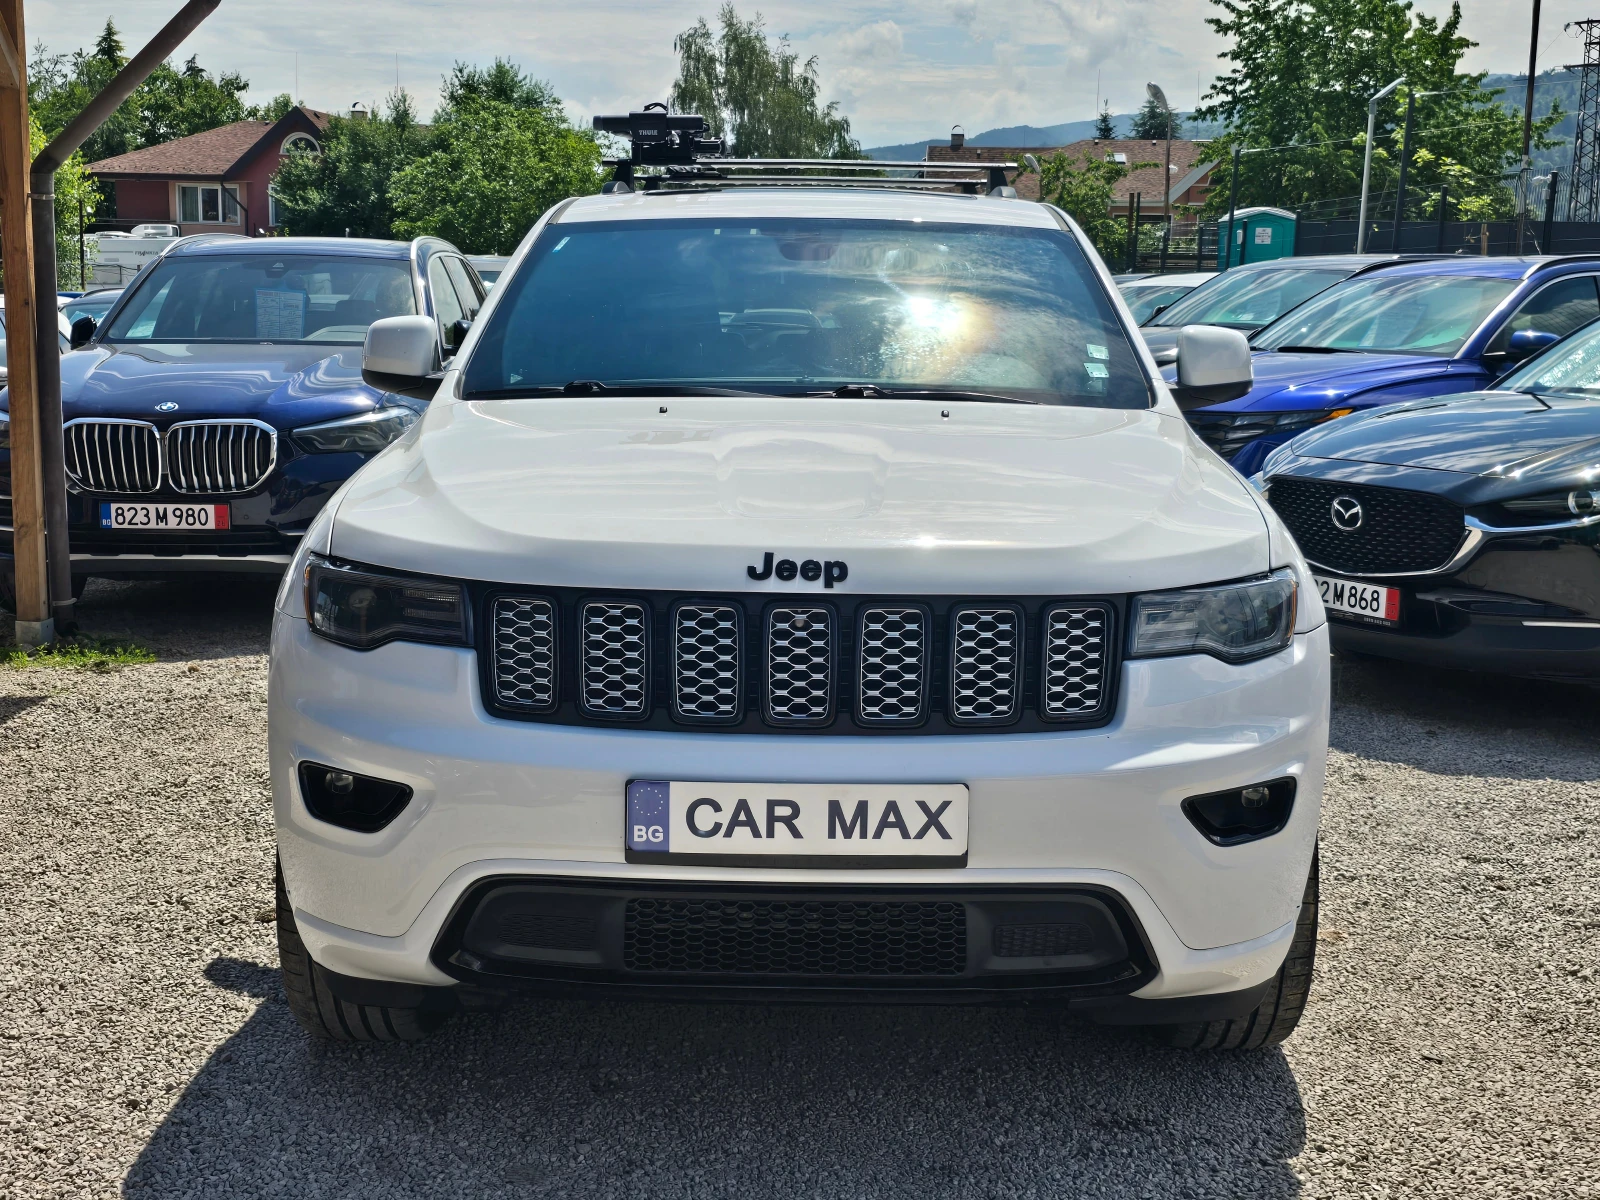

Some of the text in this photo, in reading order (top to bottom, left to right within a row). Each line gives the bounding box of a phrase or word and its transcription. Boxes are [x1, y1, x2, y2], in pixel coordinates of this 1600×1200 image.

[114, 506, 209, 527] 823 M 980
[747, 551, 849, 589] Jeep
[1333, 582, 1345, 606] M
[1348, 586, 1380, 612] 868
[633, 825, 664, 843] BG
[685, 797, 954, 841] CAR MAX
